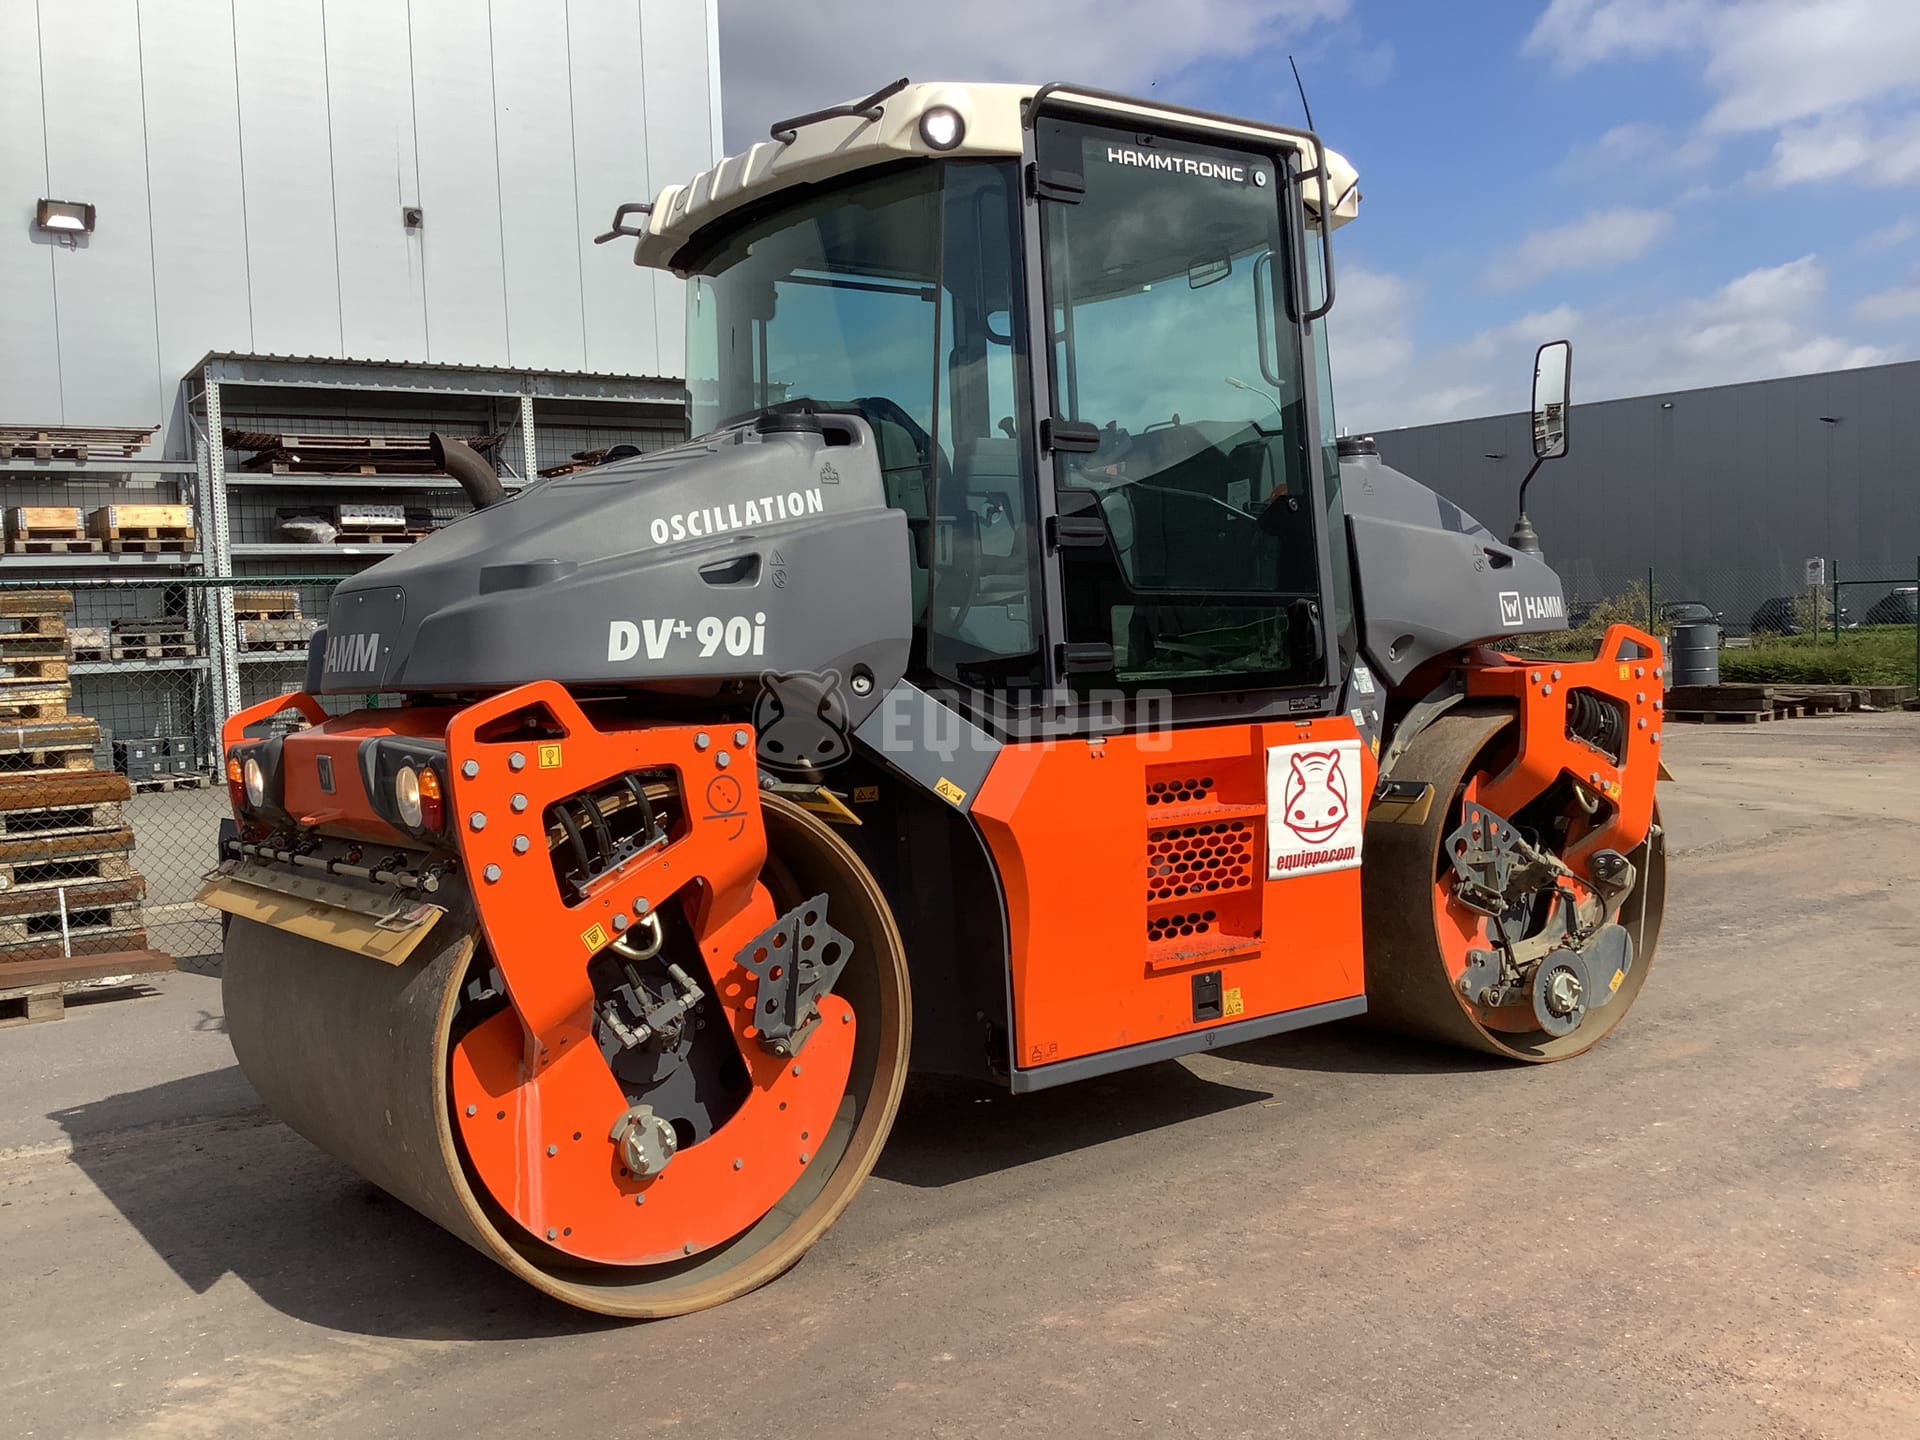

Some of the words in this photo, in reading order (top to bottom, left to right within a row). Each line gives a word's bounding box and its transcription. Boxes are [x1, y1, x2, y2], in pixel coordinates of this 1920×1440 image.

[1107, 147, 1244, 182] HAMMTRONIC
[650, 488, 824, 545] OSCILLATION
[1524, 596, 1563, 619] HAMM
[1276, 845, 1356, 871] equippo.com
